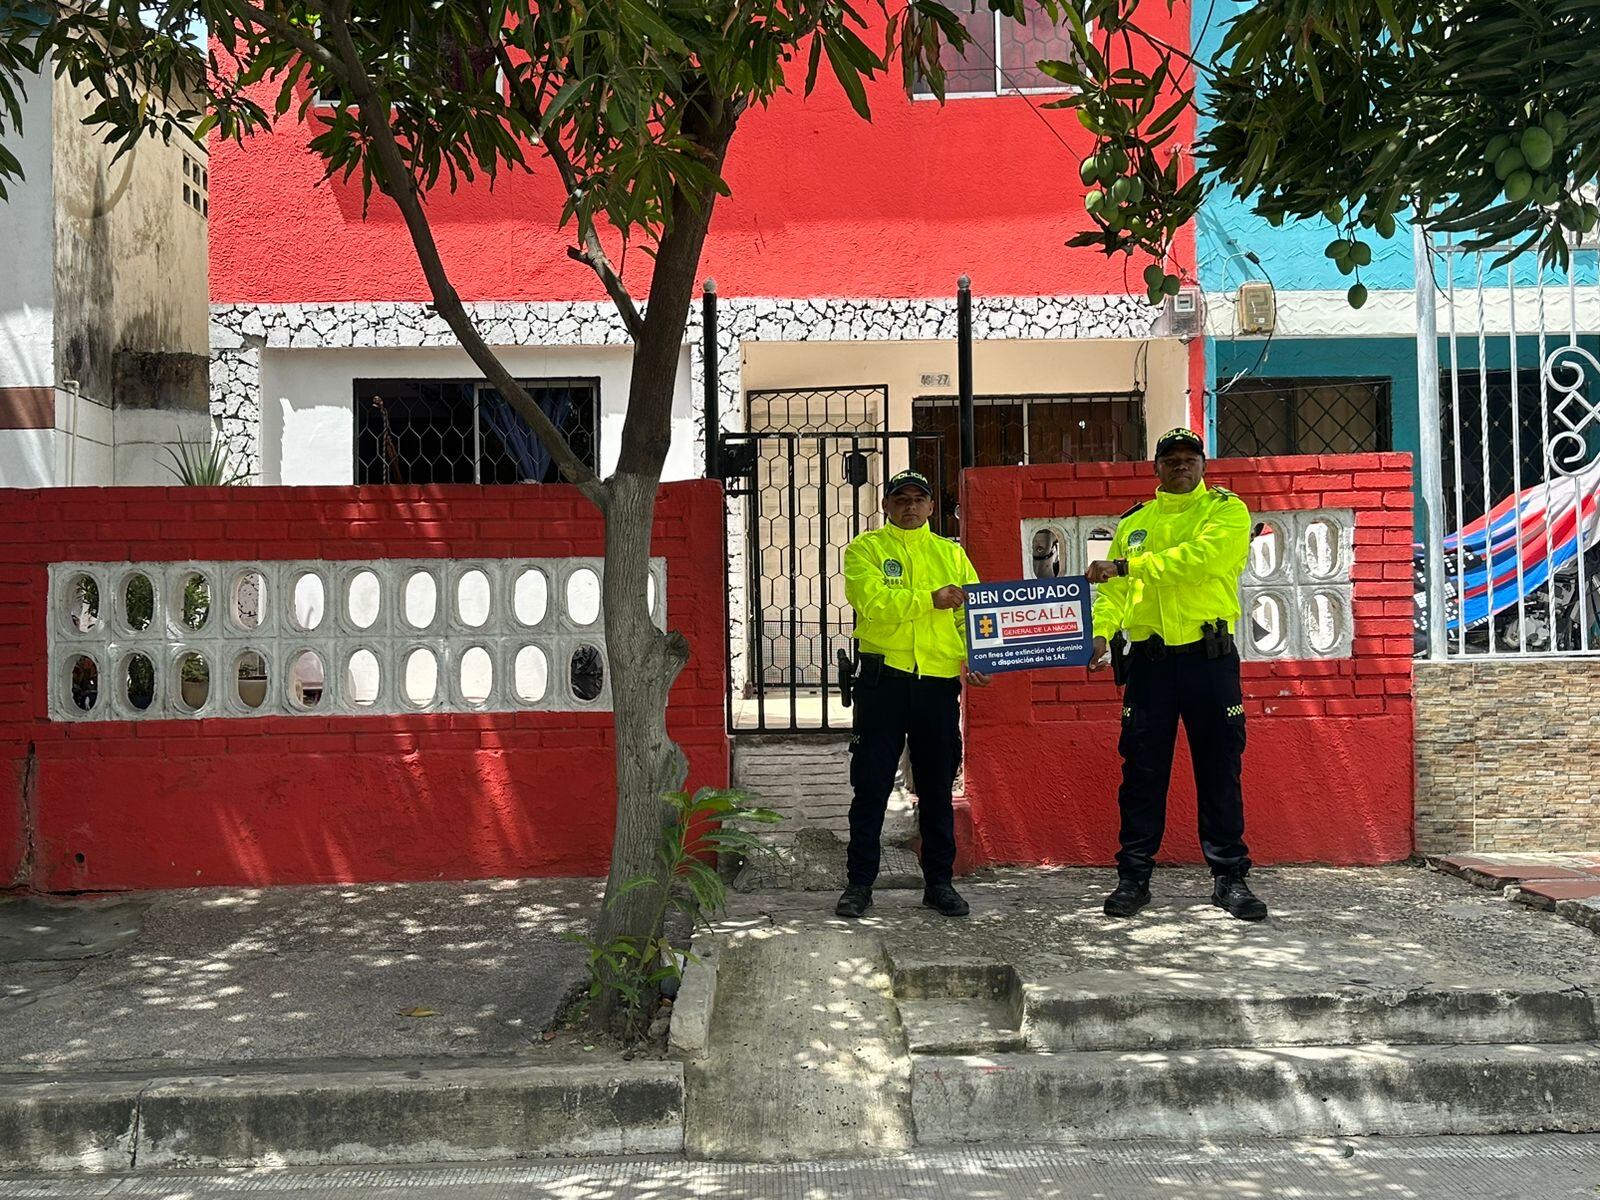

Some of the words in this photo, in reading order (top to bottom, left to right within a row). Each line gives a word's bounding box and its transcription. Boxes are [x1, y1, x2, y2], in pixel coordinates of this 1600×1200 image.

[968, 590, 999, 605] BIEN
[1002, 583, 1080, 602] OCUPADO
[1001, 604, 1076, 624] FISCALÍA
[1003, 627, 1033, 636] GENERAL
[1052, 623, 1077, 631] NACIÓN
[974, 652, 987, 660] con
[988, 651, 1004, 659] fines
[1015, 648, 1045, 656] extinción
[1056, 644, 1083, 652] dominio
[998, 656, 1035, 666] disposición
